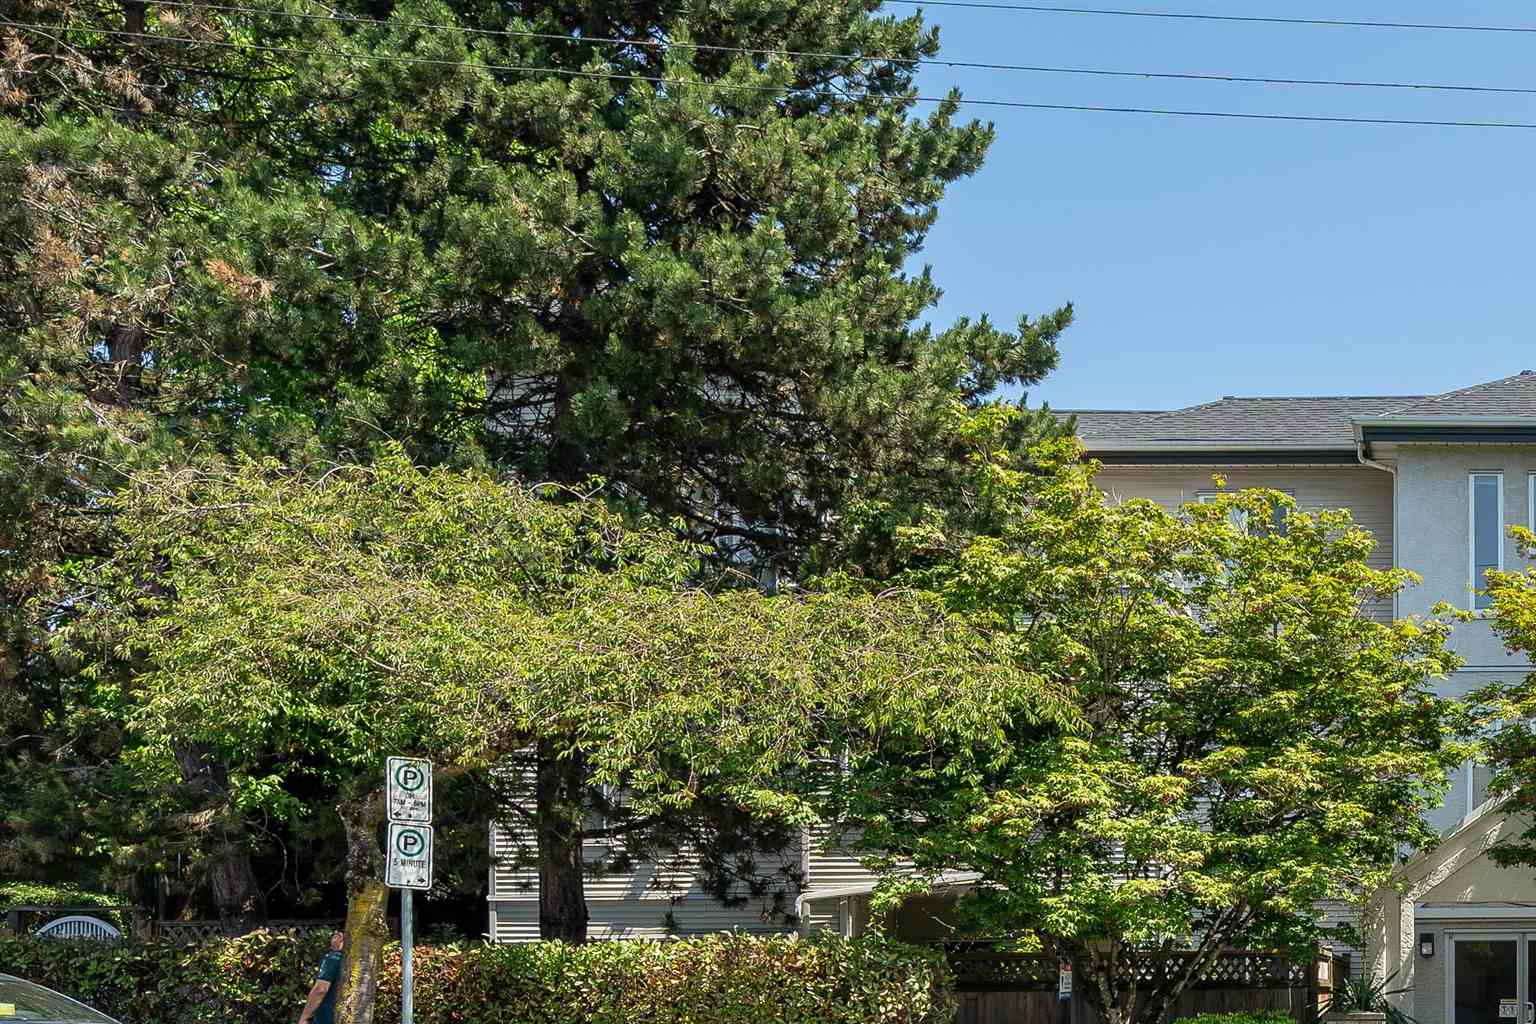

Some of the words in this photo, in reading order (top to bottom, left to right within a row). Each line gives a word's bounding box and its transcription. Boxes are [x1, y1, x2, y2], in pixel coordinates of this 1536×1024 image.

[403, 770, 417, 785] P
[403, 836, 417, 850] P
[401, 859, 427, 869] MINUTE
